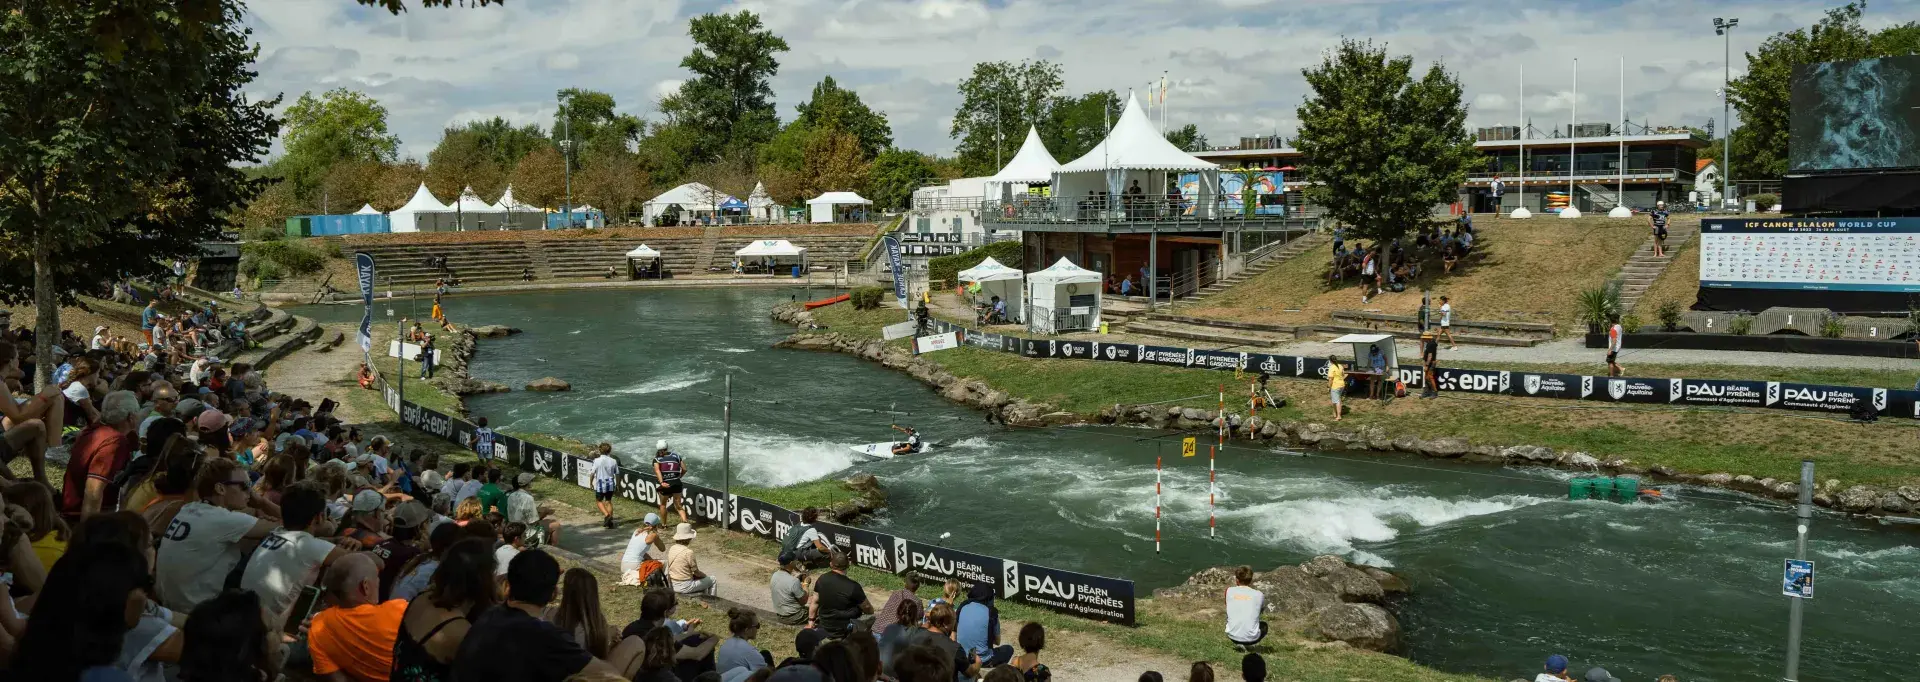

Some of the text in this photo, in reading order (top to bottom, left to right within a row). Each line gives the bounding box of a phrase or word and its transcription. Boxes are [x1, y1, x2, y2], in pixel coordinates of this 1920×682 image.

[1706, 318, 1713, 328] 2
[1787, 314, 1793, 325] 1
[1869, 327, 1877, 337] 3
[1400, 369, 1421, 385] DF
[1686, 382, 1725, 396] PAU
[1784, 387, 1827, 402] PAU
[1783, 400, 1818, 408] Communauté
[1184, 440, 1195, 455] 24
[667, 462, 674, 471] 7
[856, 543, 887, 568] FFCK
[912, 552, 955, 575] PAU
[1024, 574, 1075, 600] PAU
[1025, 594, 1125, 619] Communauté d'Agglomération
